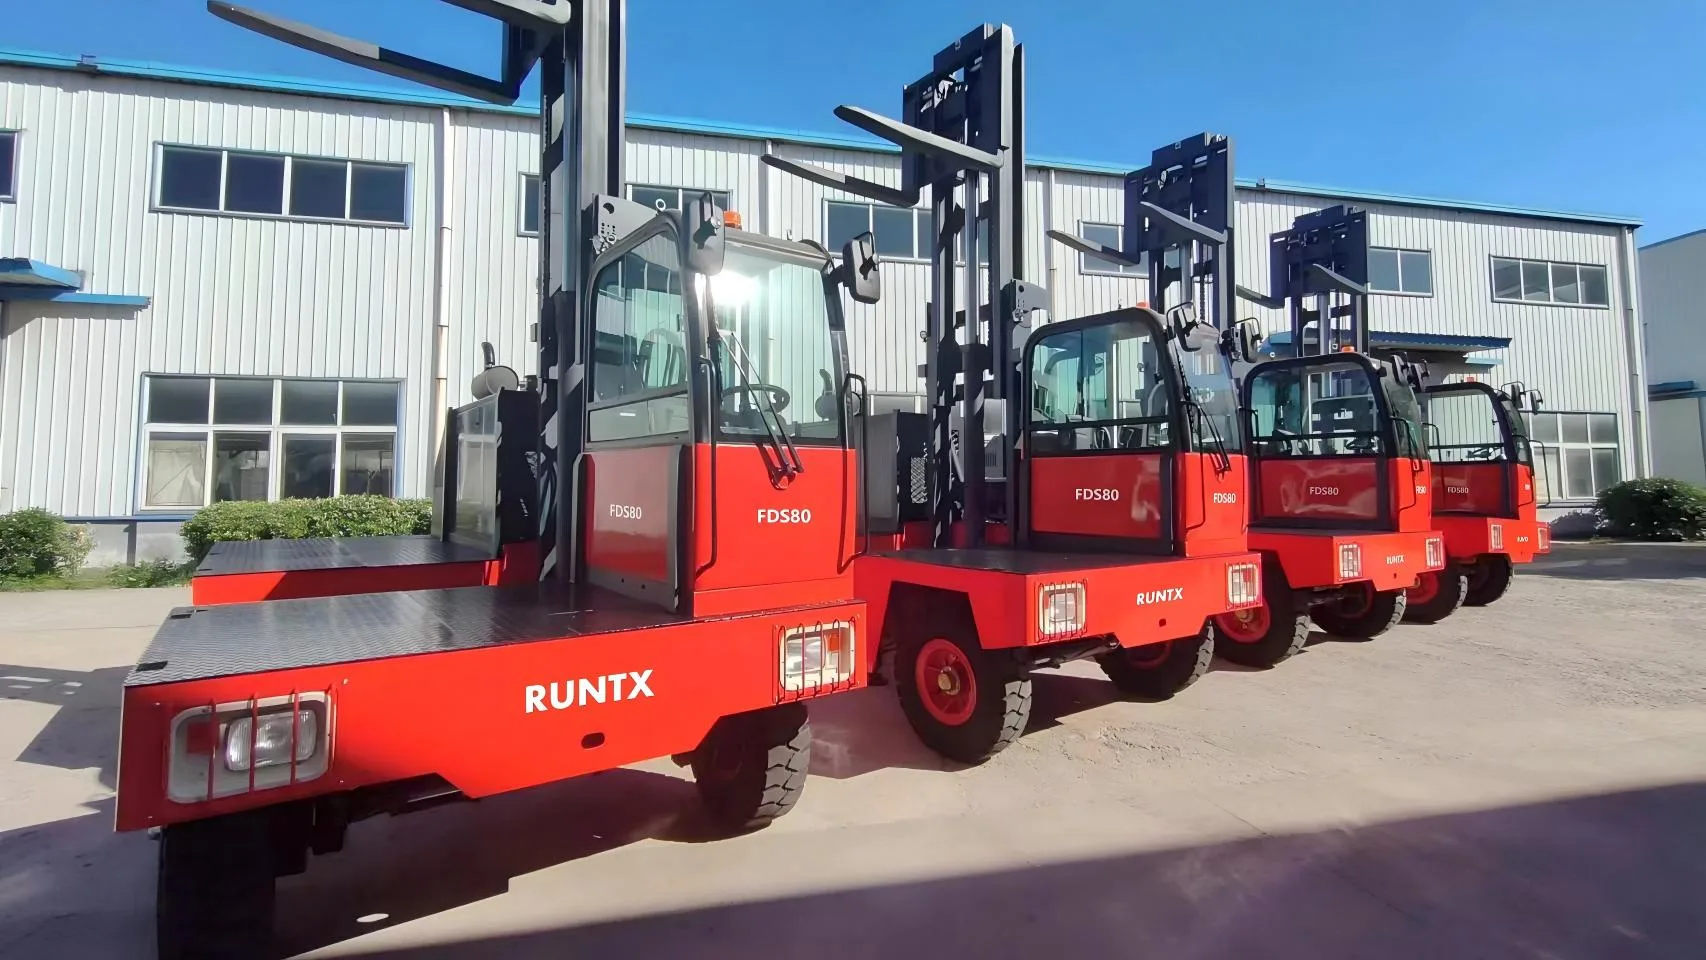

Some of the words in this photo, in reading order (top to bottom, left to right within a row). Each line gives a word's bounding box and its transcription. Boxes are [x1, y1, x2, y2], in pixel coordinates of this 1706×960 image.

[1076, 489, 1120, 501] FDS80
[1214, 493, 1236, 504] FDS80
[1310, 486, 1339, 495] FDS80
[610, 504, 642, 520] FDS80
[757, 508, 811, 524] FDS80
[1137, 588, 1184, 606] RUNTX
[525, 669, 655, 713] RUNTX
